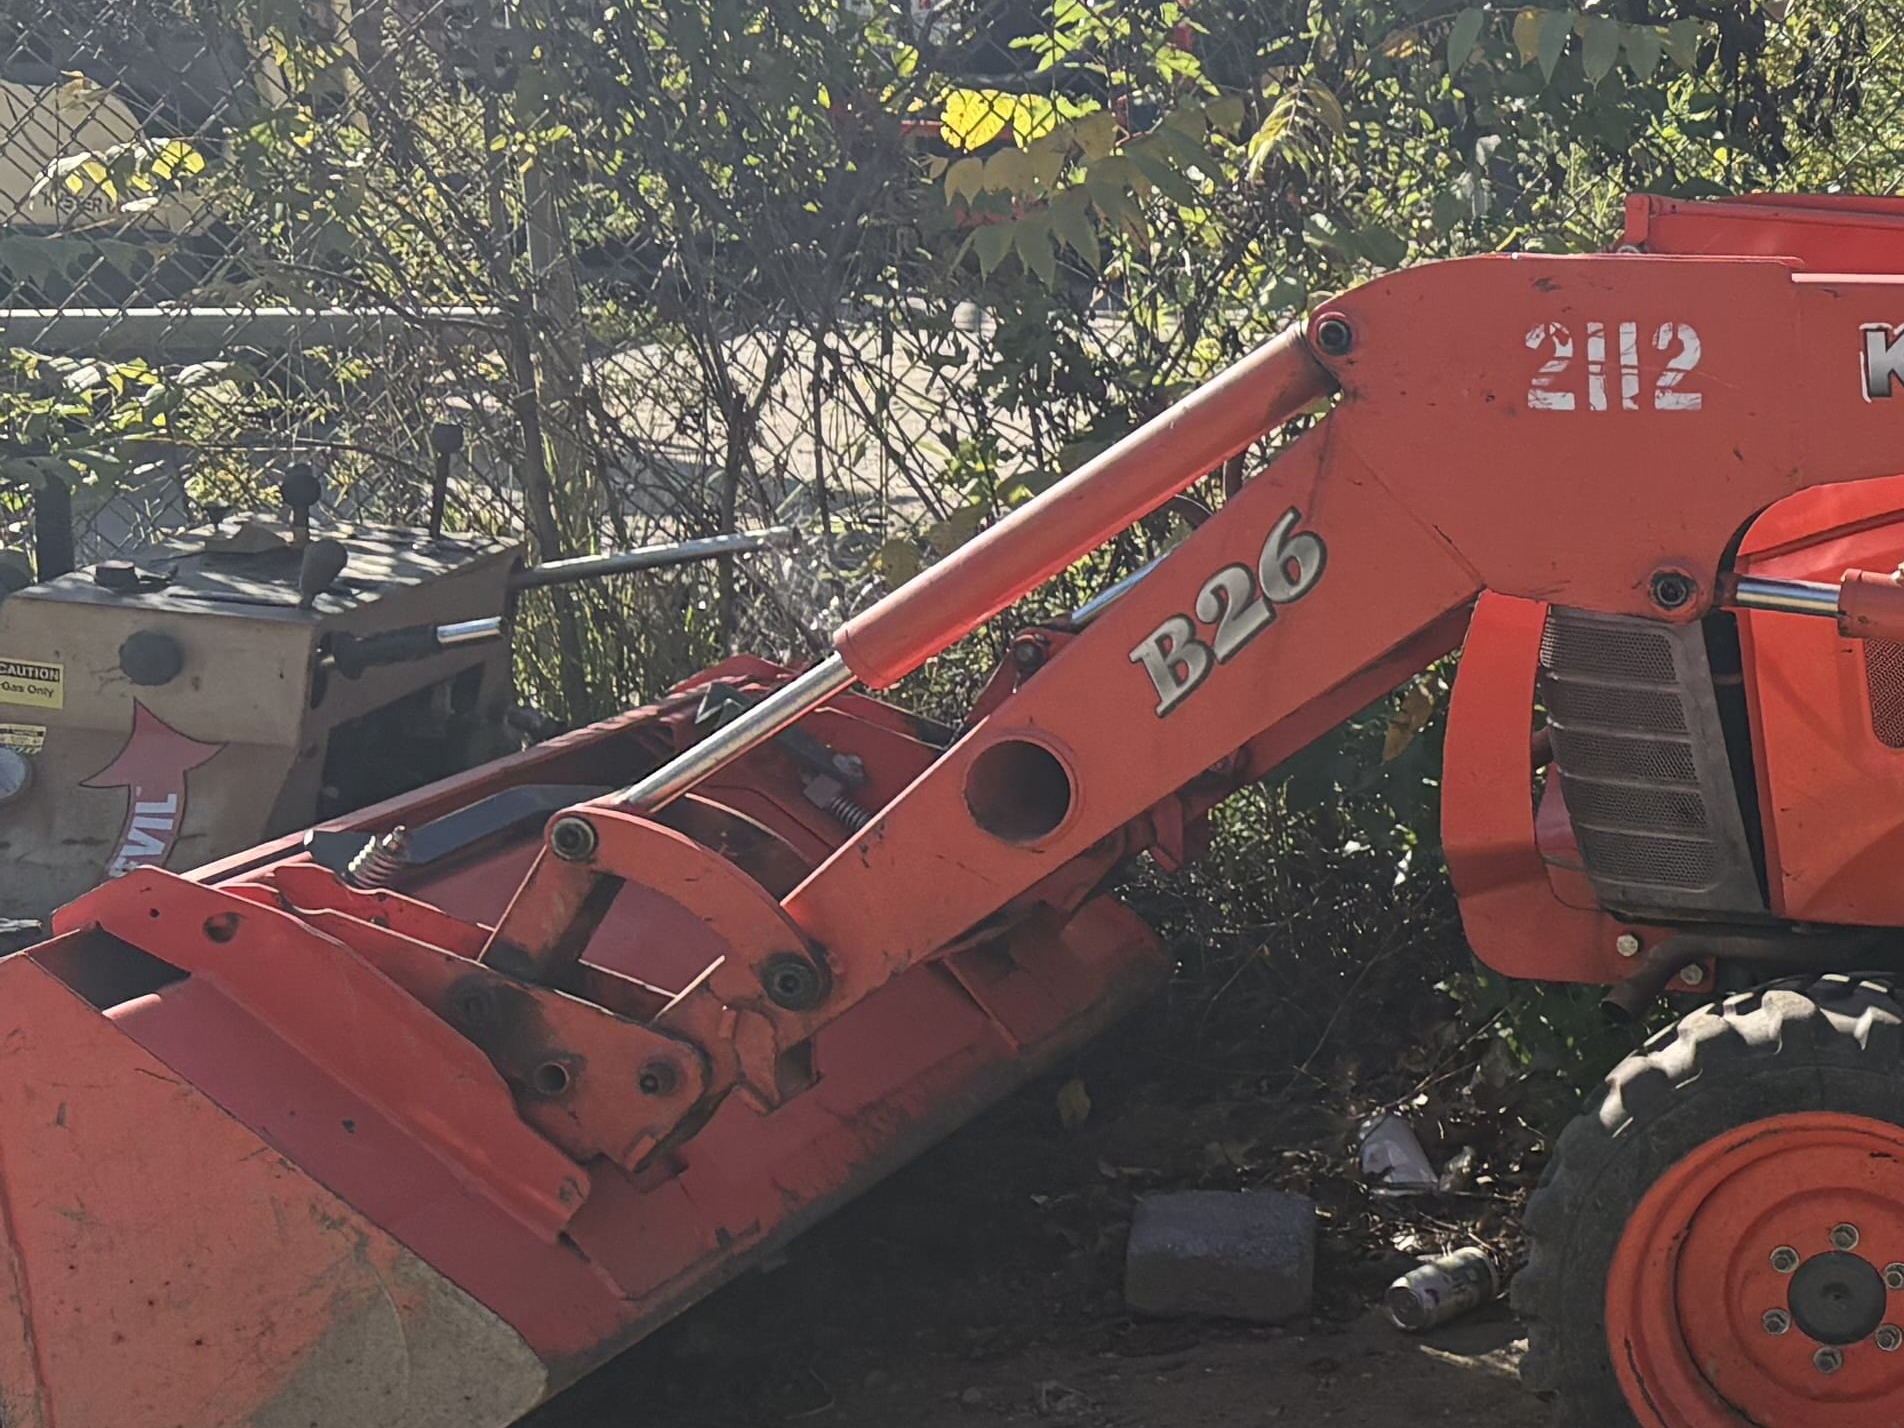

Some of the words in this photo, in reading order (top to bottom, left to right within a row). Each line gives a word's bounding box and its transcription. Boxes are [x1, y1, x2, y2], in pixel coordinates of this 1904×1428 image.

[1525, 322, 1702, 411] 2112
[1128, 506, 1327, 718] B26
[0, 663, 59, 681] CAUTION
[28, 685, 54, 698] Only
